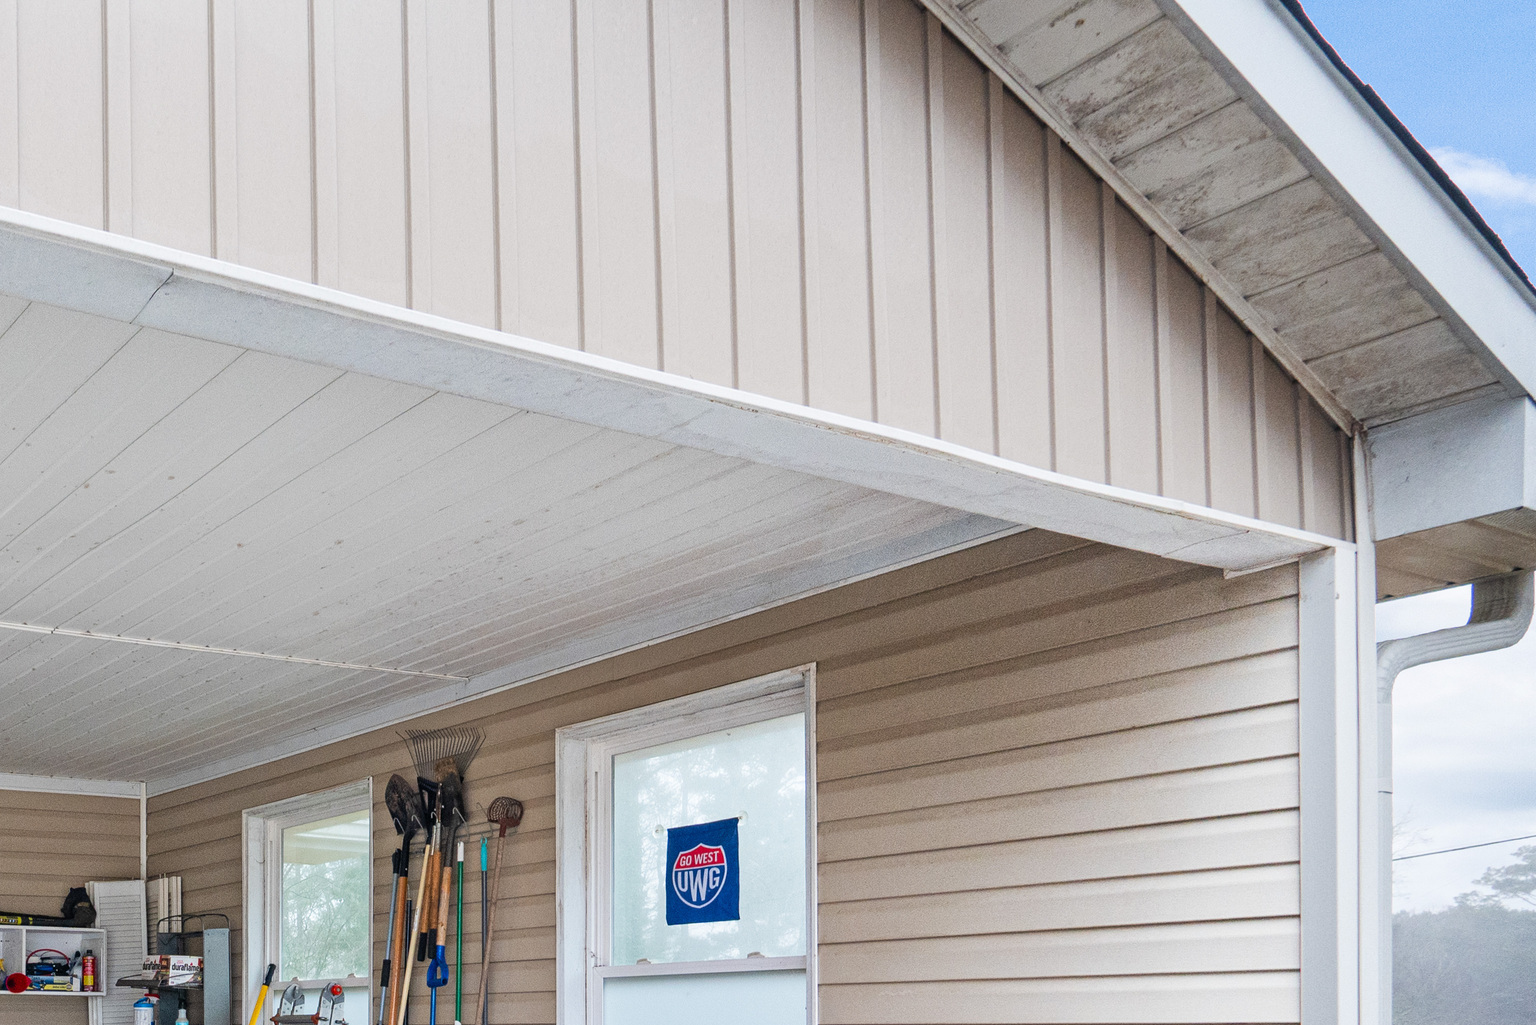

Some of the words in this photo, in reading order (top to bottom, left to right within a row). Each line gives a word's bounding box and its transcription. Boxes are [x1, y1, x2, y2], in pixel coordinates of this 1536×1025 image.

[680, 855, 692, 867] GO
[694, 851, 719, 864] WEST
[677, 867, 720, 902] UWG
[172, 963, 200, 971] duraflame
